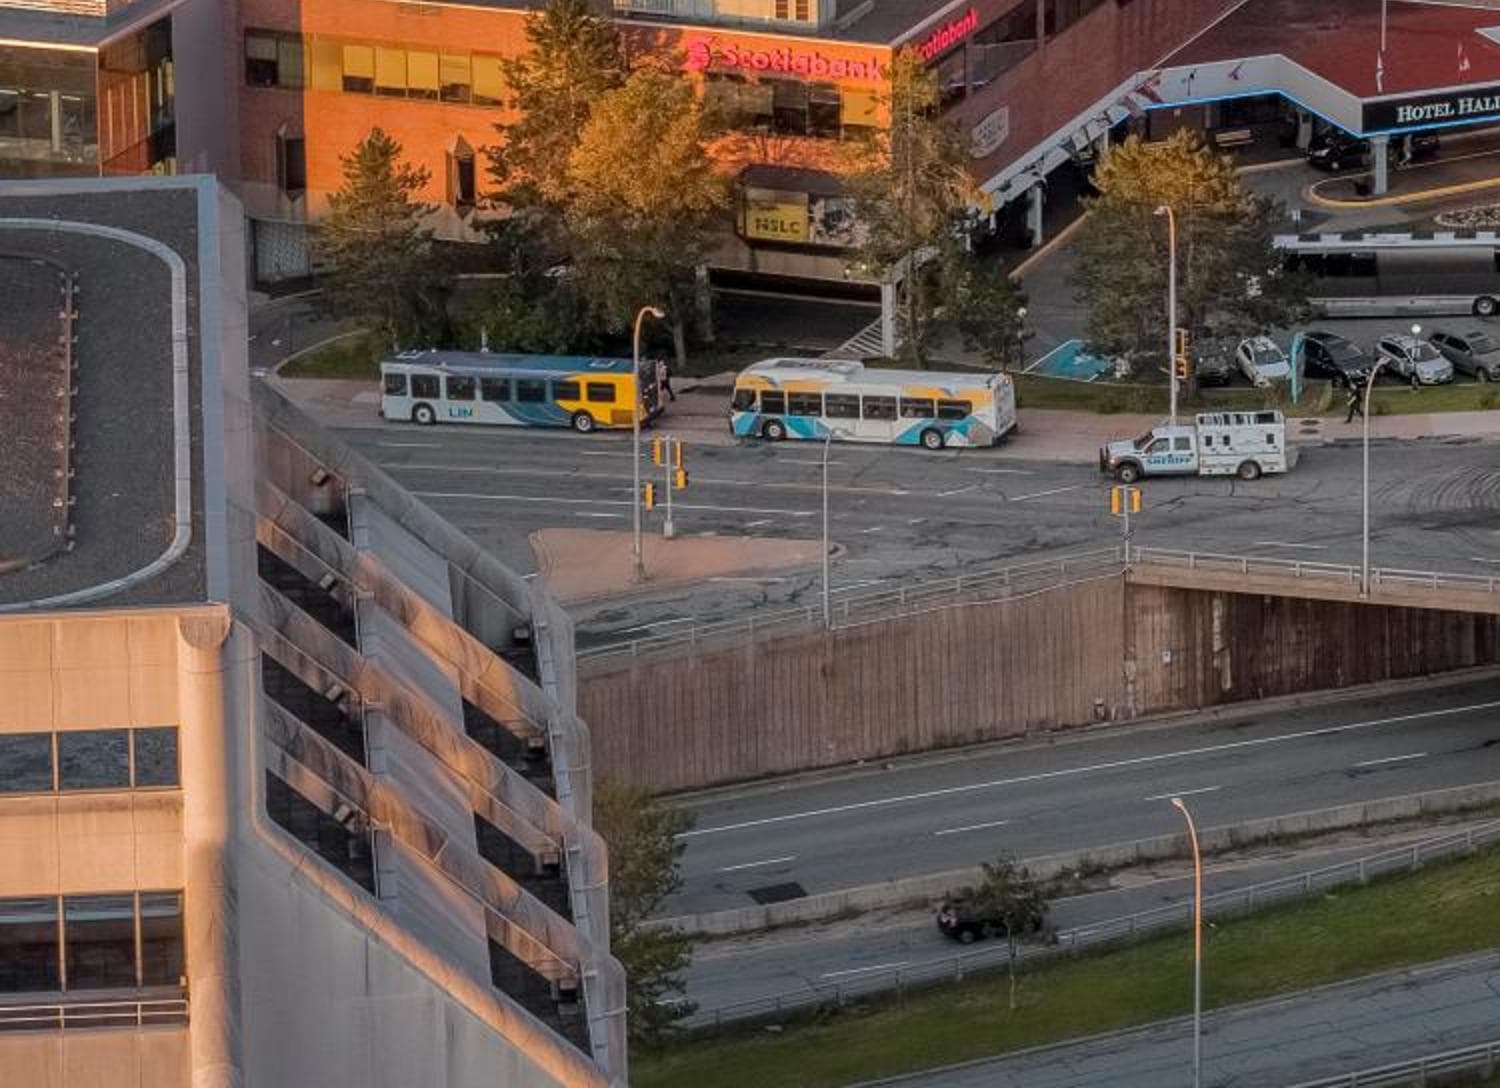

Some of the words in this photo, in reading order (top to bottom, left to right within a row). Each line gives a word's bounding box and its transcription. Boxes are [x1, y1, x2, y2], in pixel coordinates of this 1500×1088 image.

[720, 41, 884, 82] Scotiabank
[1396, 102, 1455, 124] HOTEL
[754, 217, 801, 235] NSLC
